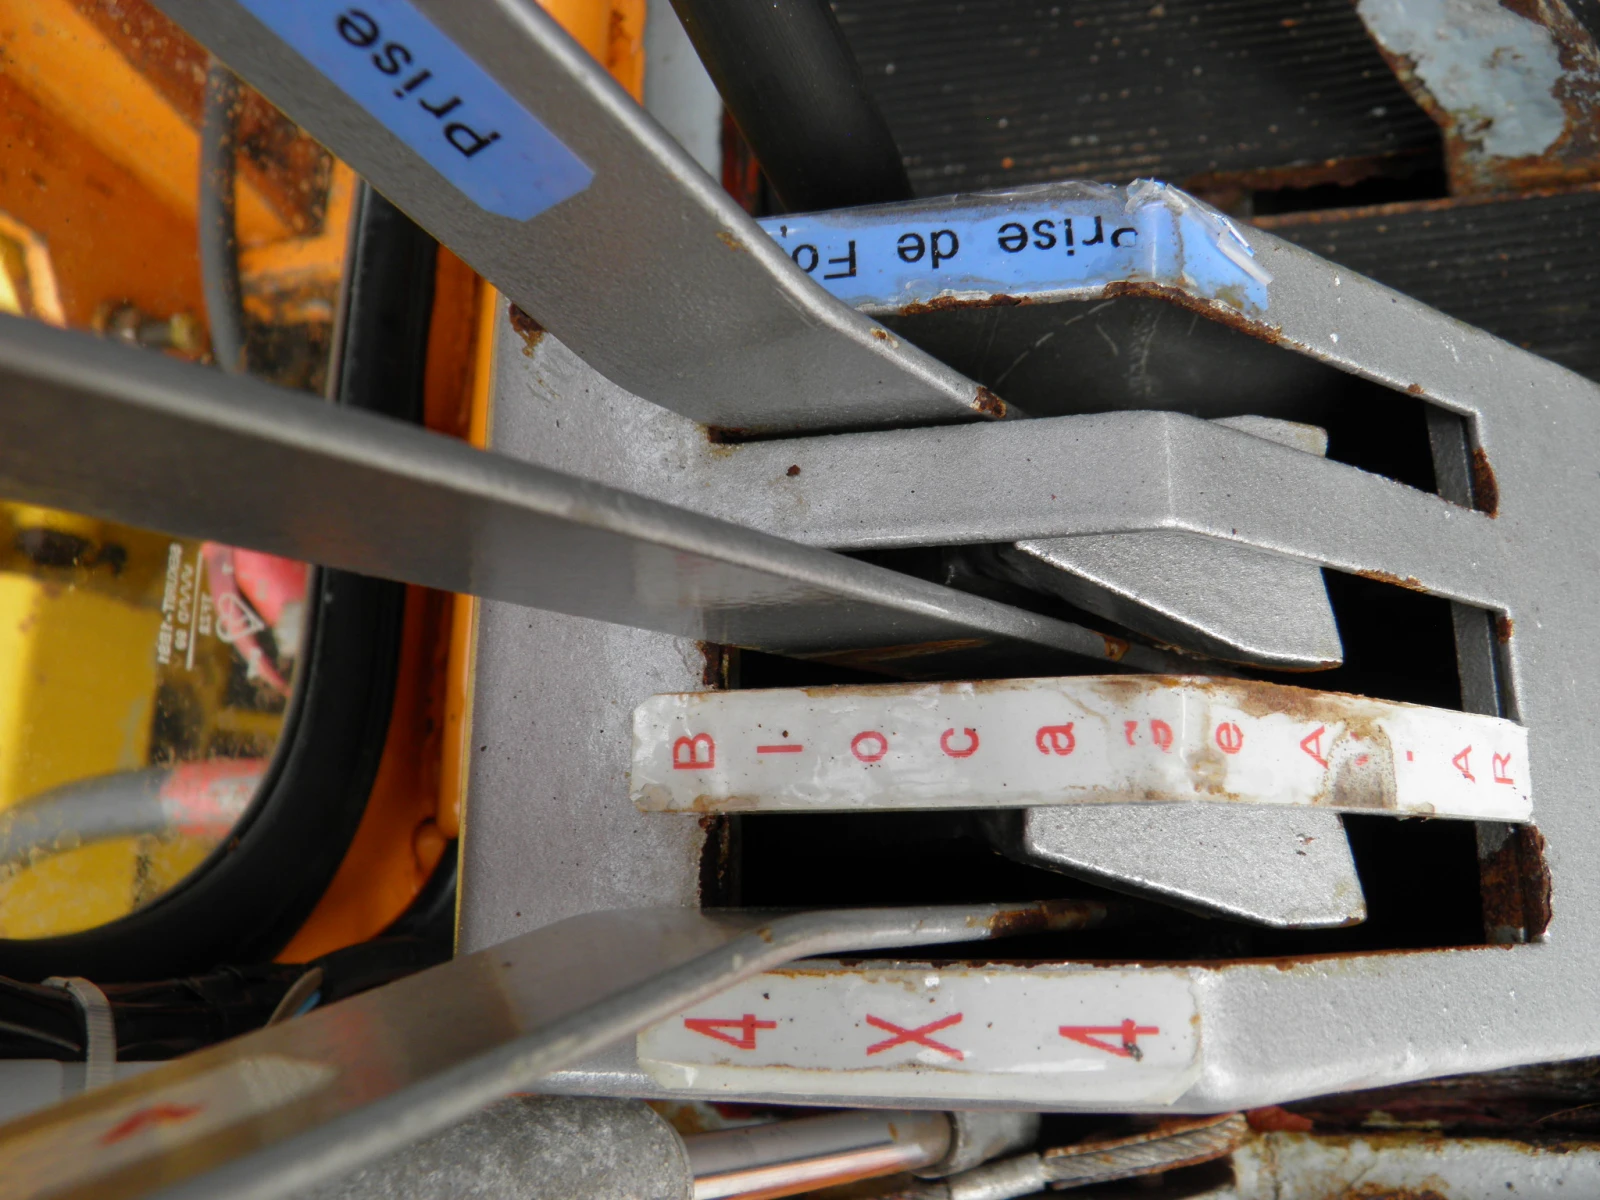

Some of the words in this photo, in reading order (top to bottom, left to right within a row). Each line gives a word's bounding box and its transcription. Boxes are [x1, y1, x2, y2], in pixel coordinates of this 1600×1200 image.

[335, 9, 502, 160] Prise
[780, 226, 857, 281] Fo
[897, 229, 960, 270] de
